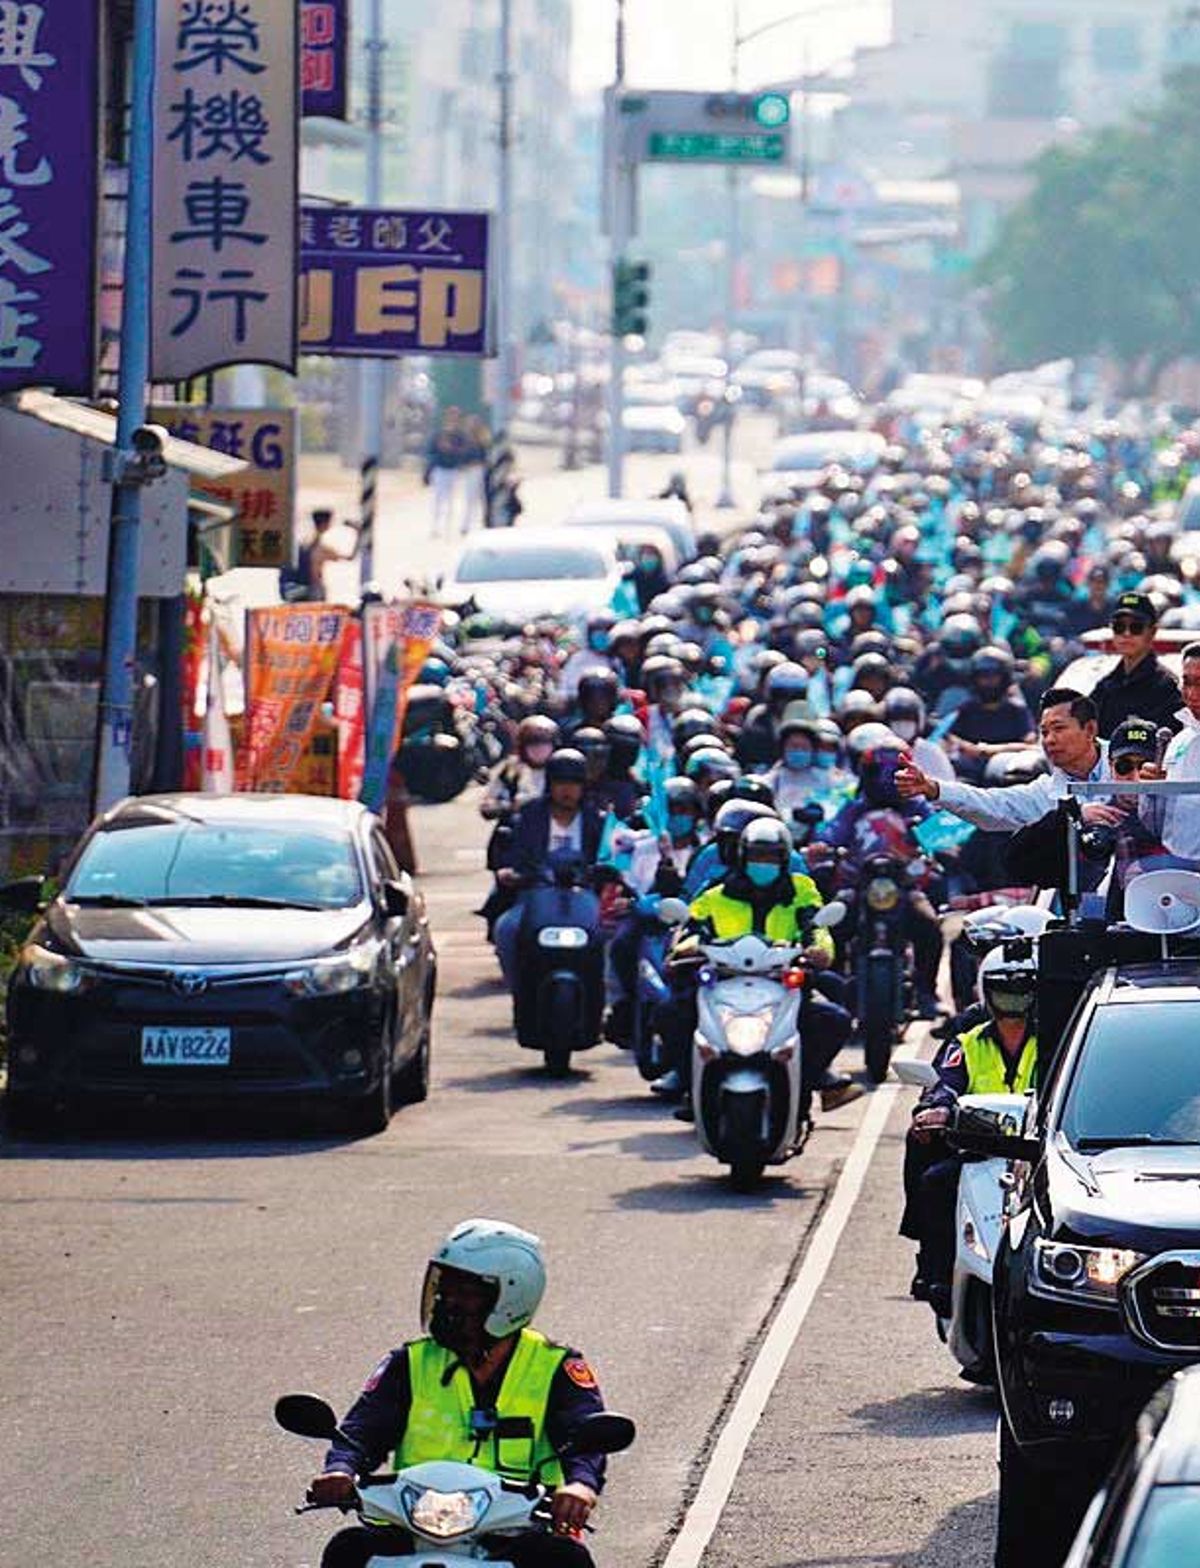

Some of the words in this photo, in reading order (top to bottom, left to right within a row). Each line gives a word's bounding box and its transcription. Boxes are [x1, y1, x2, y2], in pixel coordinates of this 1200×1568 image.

[167, 0, 271, 343] 榮機車行
[1127, 730, 1147, 740] SSC
